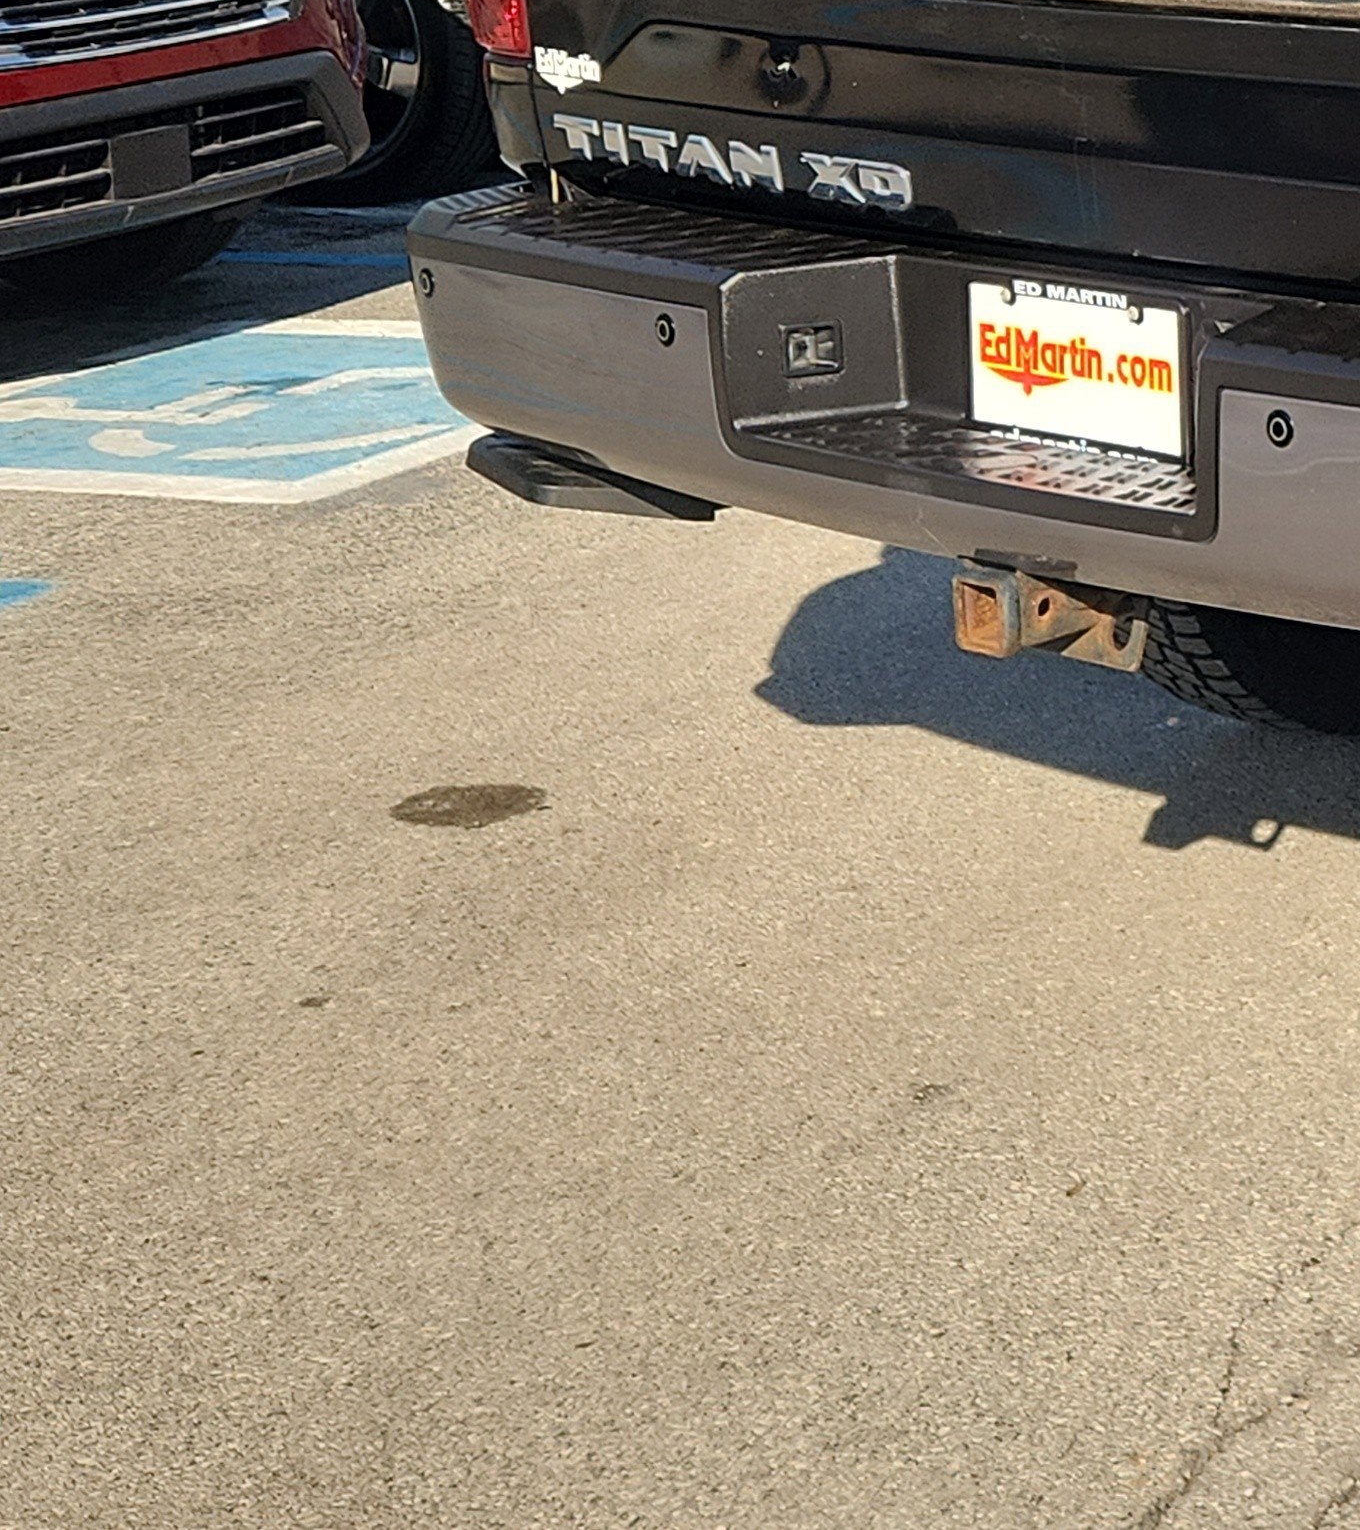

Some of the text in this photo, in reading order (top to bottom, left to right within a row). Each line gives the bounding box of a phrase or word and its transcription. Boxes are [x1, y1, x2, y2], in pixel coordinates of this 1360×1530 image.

[553, 113, 912, 210] TITAN XD
[1012, 280, 1127, 309] ED MARTIN
[979, 323, 1172, 393] EdMartin.com
